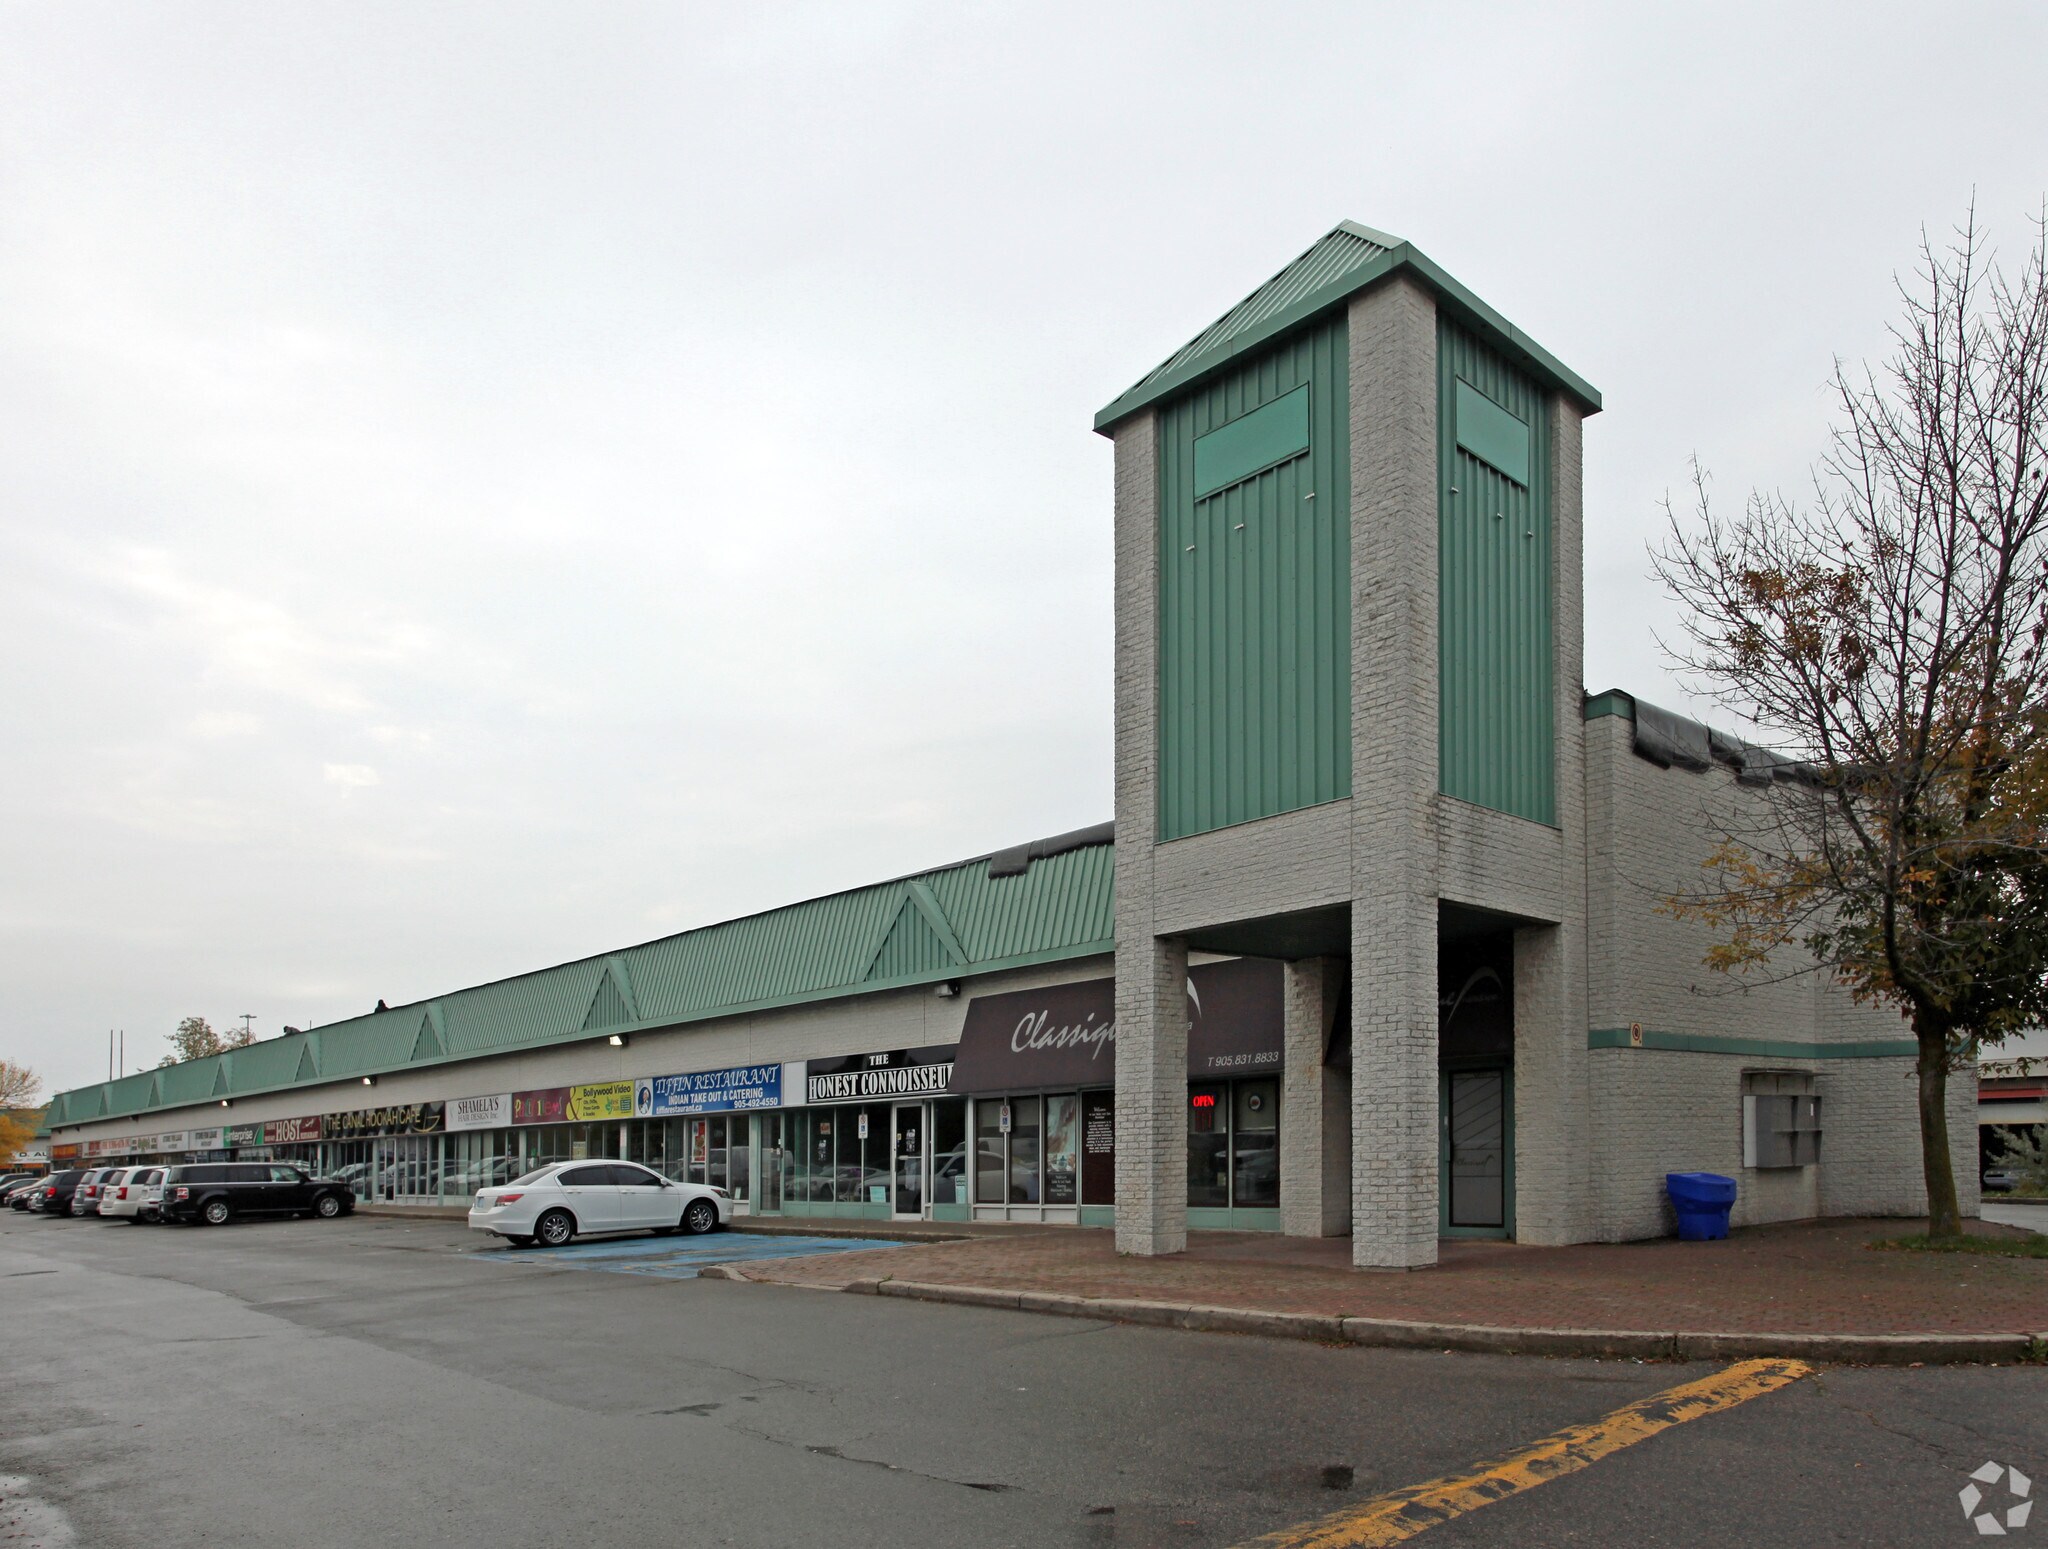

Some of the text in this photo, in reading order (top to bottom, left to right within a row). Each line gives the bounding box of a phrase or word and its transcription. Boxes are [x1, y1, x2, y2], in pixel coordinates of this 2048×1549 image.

[869, 1054, 889, 1066] THE
[1208, 1052, 1279, 1067] T 905.831.8833
[656, 1076, 693, 1096] TIFFIN
[694, 1064, 779, 1091] RESTAURANT
[808, 1073, 858, 1100] HONEST
[583, 1086, 613, 1099] Bollywood
[614, 1084, 631, 1094] Video
[668, 1087, 763, 1106] INDIAN TAKE OUT & CATERING
[458, 1097, 499, 1114] SHAMELA'S
[734, 1097, 778, 1109] 905-492-4550
[1193, 1095, 1215, 1107] OPEN
[458, 1113, 470, 1122] HAIR
[471, 1111, 489, 1121] DESIGN
[656, 1104, 702, 1115] tiffinrestaurant.ca
[328, 1116, 340, 1130] THE
[342, 1114, 365, 1129] CANAL
[366, 1110, 398, 1127] HOOKAH
[275, 1119, 302, 1142] HOST
